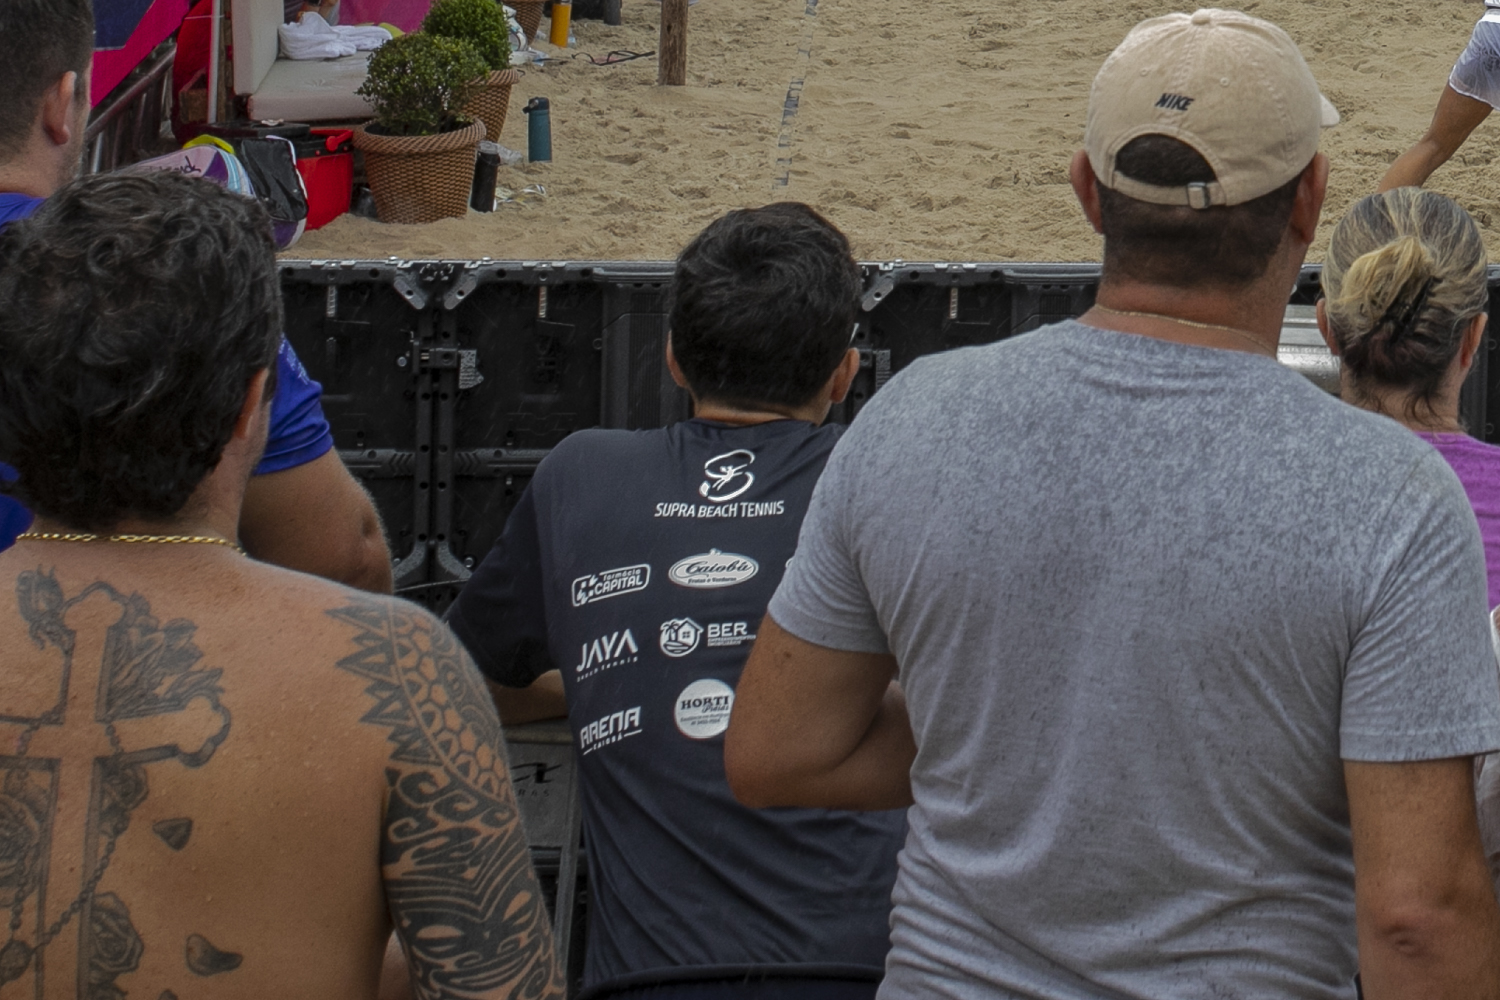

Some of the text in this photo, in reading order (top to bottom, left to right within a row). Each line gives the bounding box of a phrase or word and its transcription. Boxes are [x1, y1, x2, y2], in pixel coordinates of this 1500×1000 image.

[1154, 92, 1195, 111] NIKE
[654, 500, 785, 518] SUPRA BEACH TENNIS
[594, 575, 643, 595] CAPITAL
[708, 622, 748, 637] BER
[576, 628, 639, 672] JAYA
[681, 696, 730, 710] HORTI
[580, 706, 641, 749] ARENA
